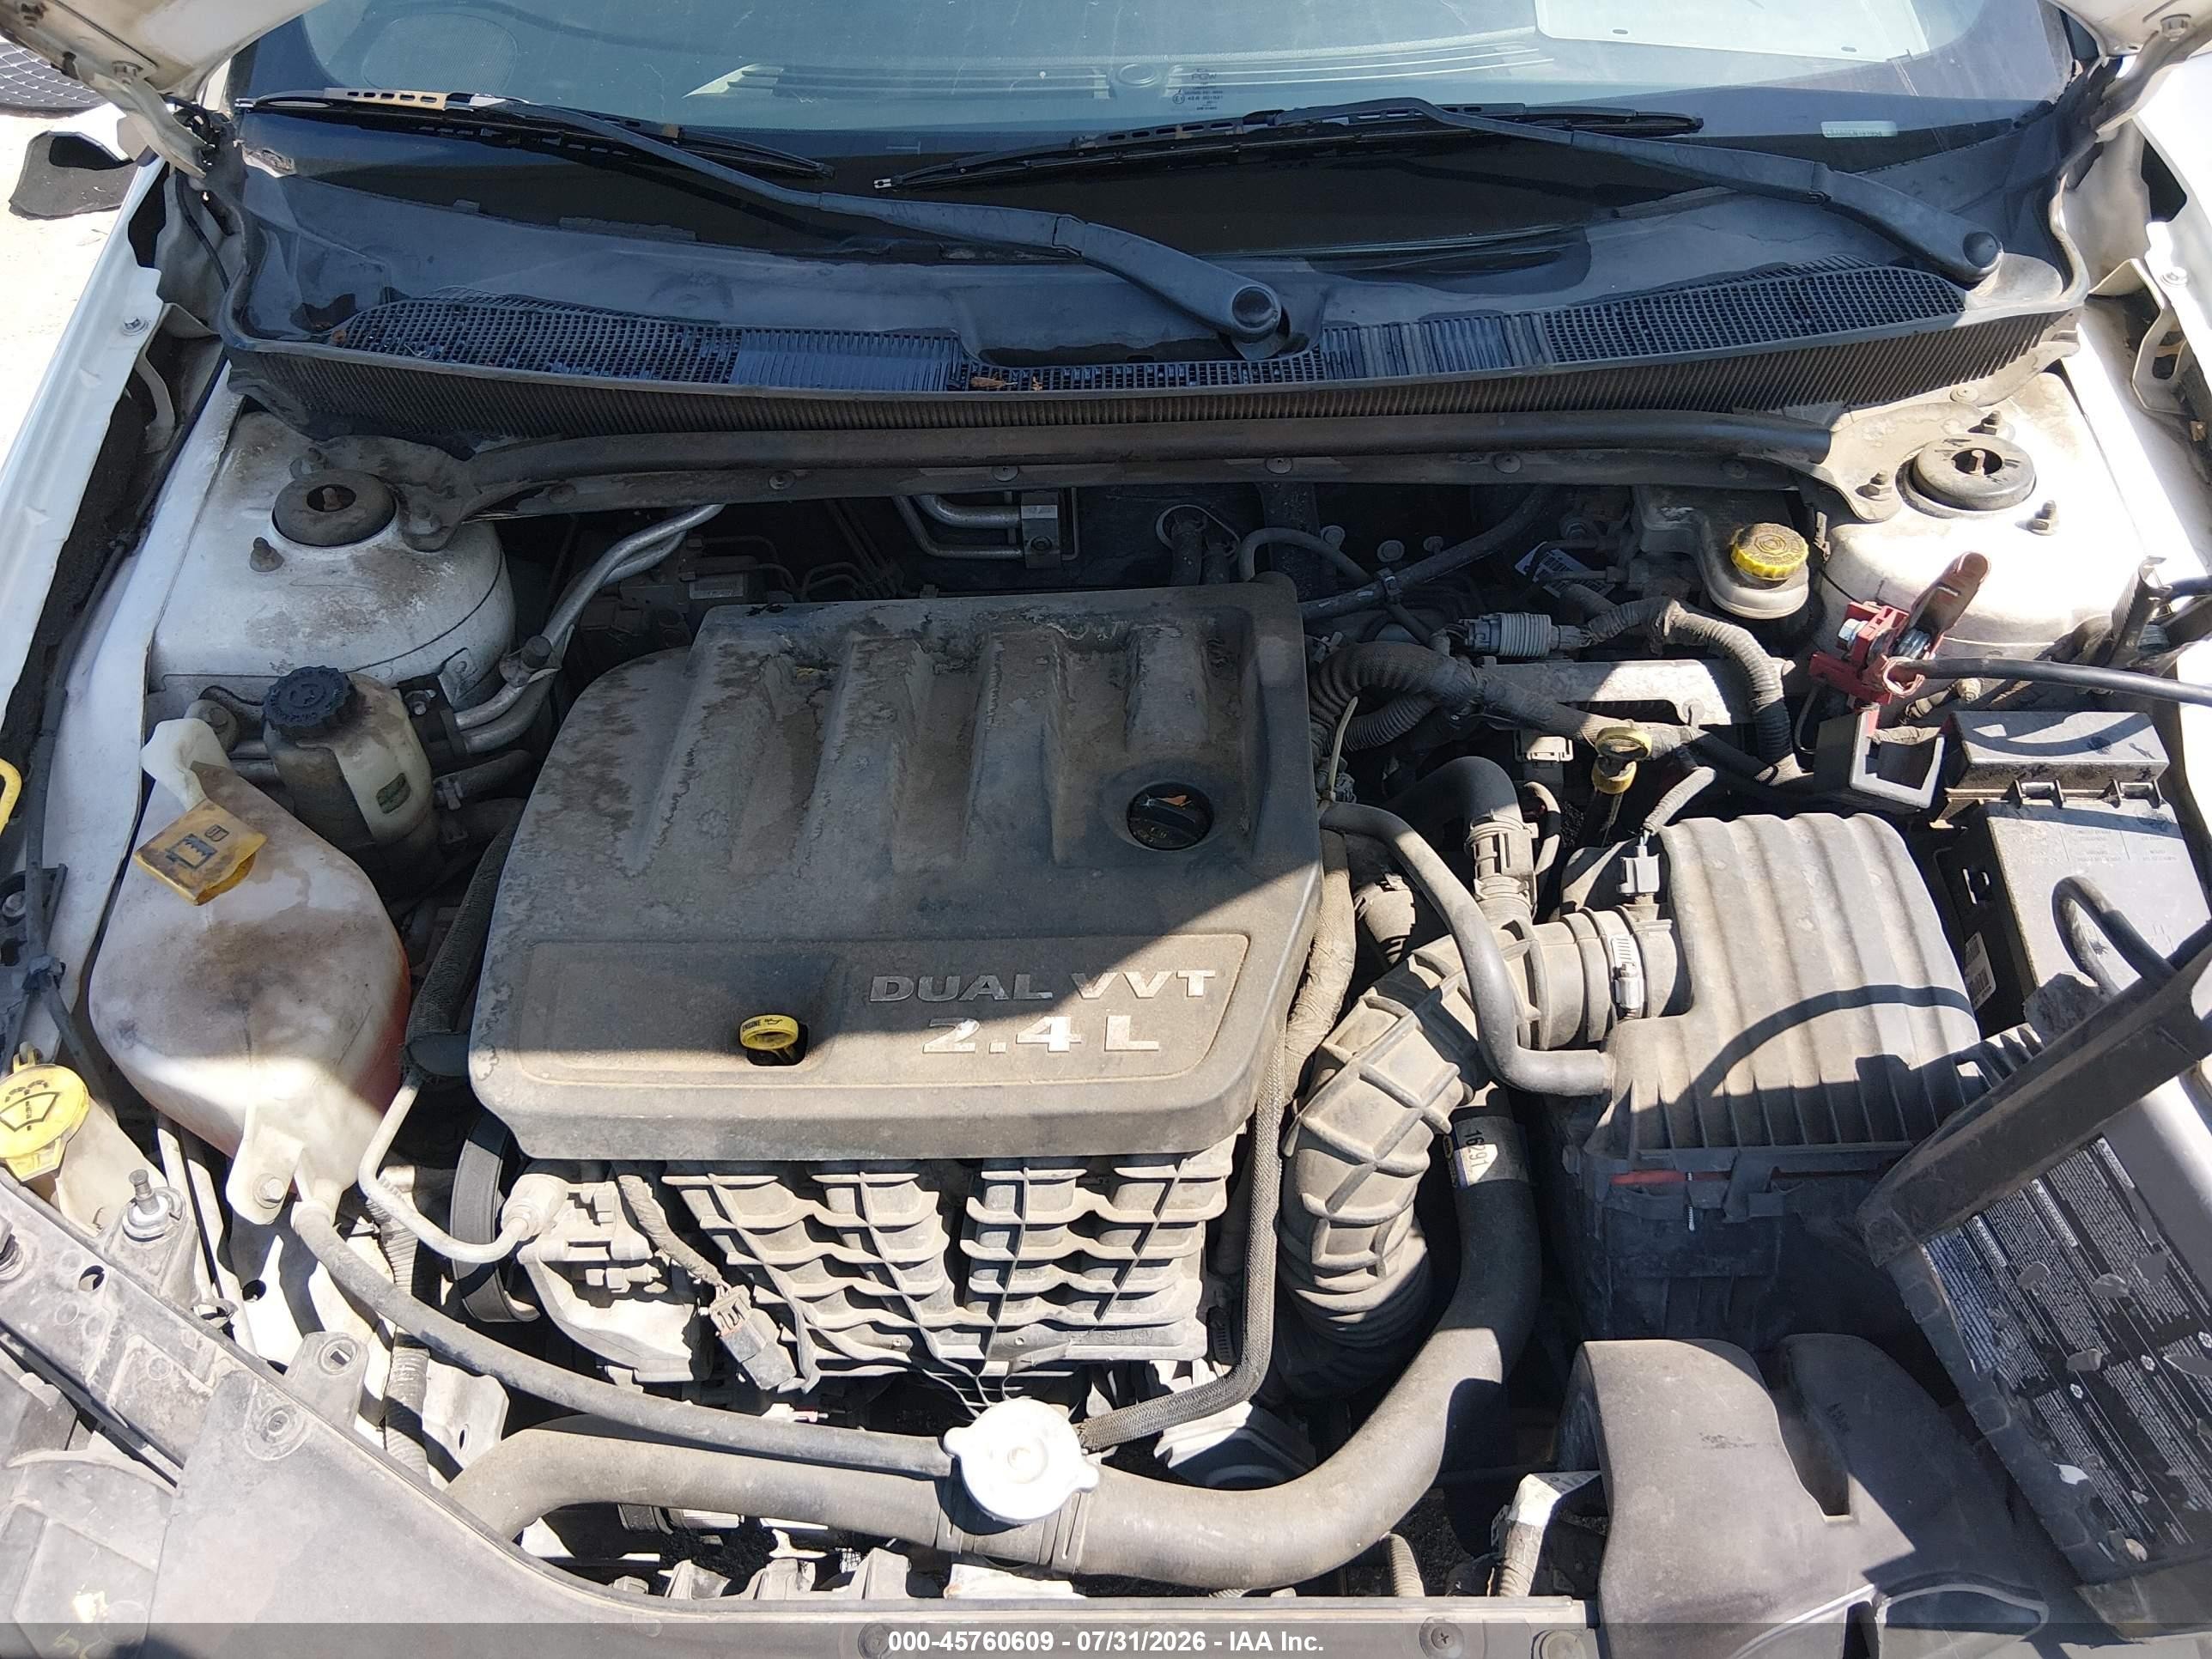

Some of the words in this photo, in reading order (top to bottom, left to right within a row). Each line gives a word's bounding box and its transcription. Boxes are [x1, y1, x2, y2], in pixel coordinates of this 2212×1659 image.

[870, 975, 1053, 1002] DUAL
[1071, 969, 1216, 1000] VVT
[742, 1019, 762, 1032] ENGINE
[922, 1015, 1160, 1054] 2.4L
[1464, 1129, 1489, 1168] 16291
[2104, 1147, 2133, 1187] WARNING
[2039, 1191, 2075, 1245] ADVERTENCIA
[1978, 1224, 2006, 1266] ATTENTION
